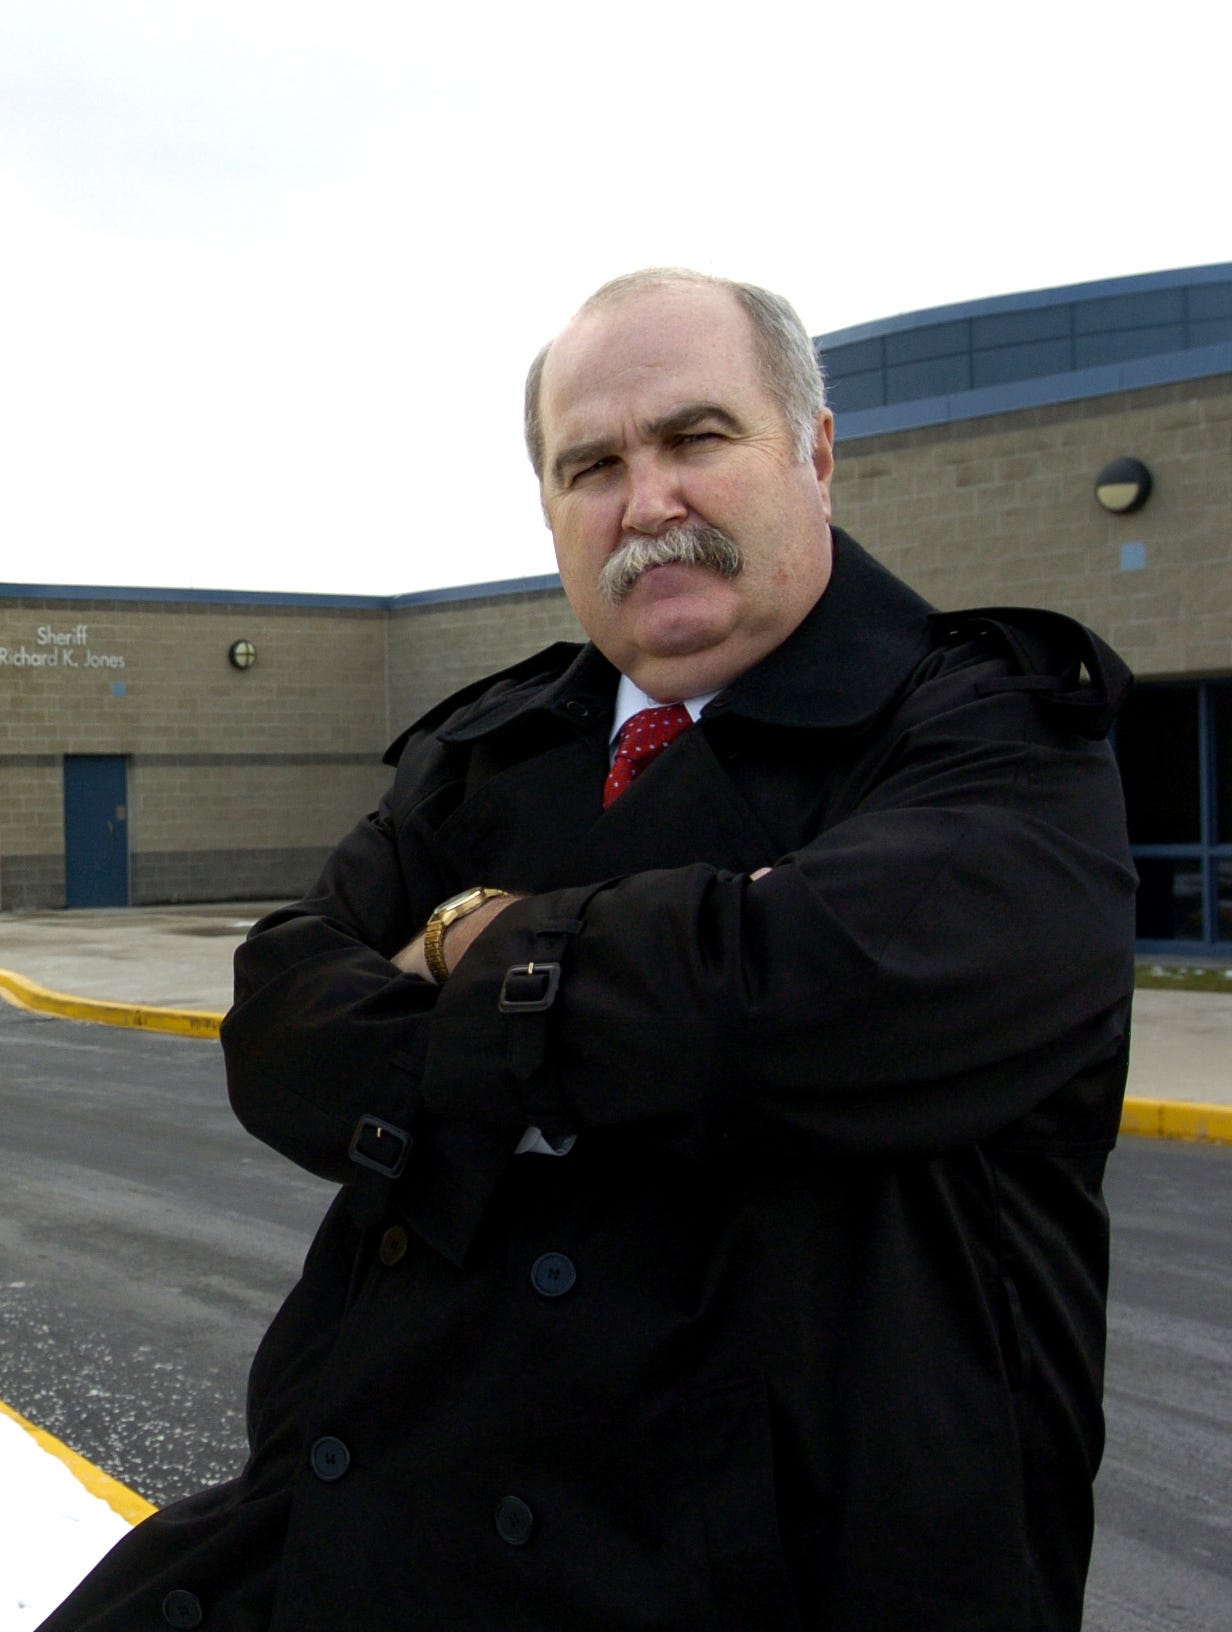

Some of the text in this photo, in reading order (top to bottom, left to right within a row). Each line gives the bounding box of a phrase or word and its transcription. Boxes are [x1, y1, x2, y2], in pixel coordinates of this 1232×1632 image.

[37, 625, 88, 645] Sheriff
[63, 649, 78, 668] K.
[84, 650, 125, 669] Jones
